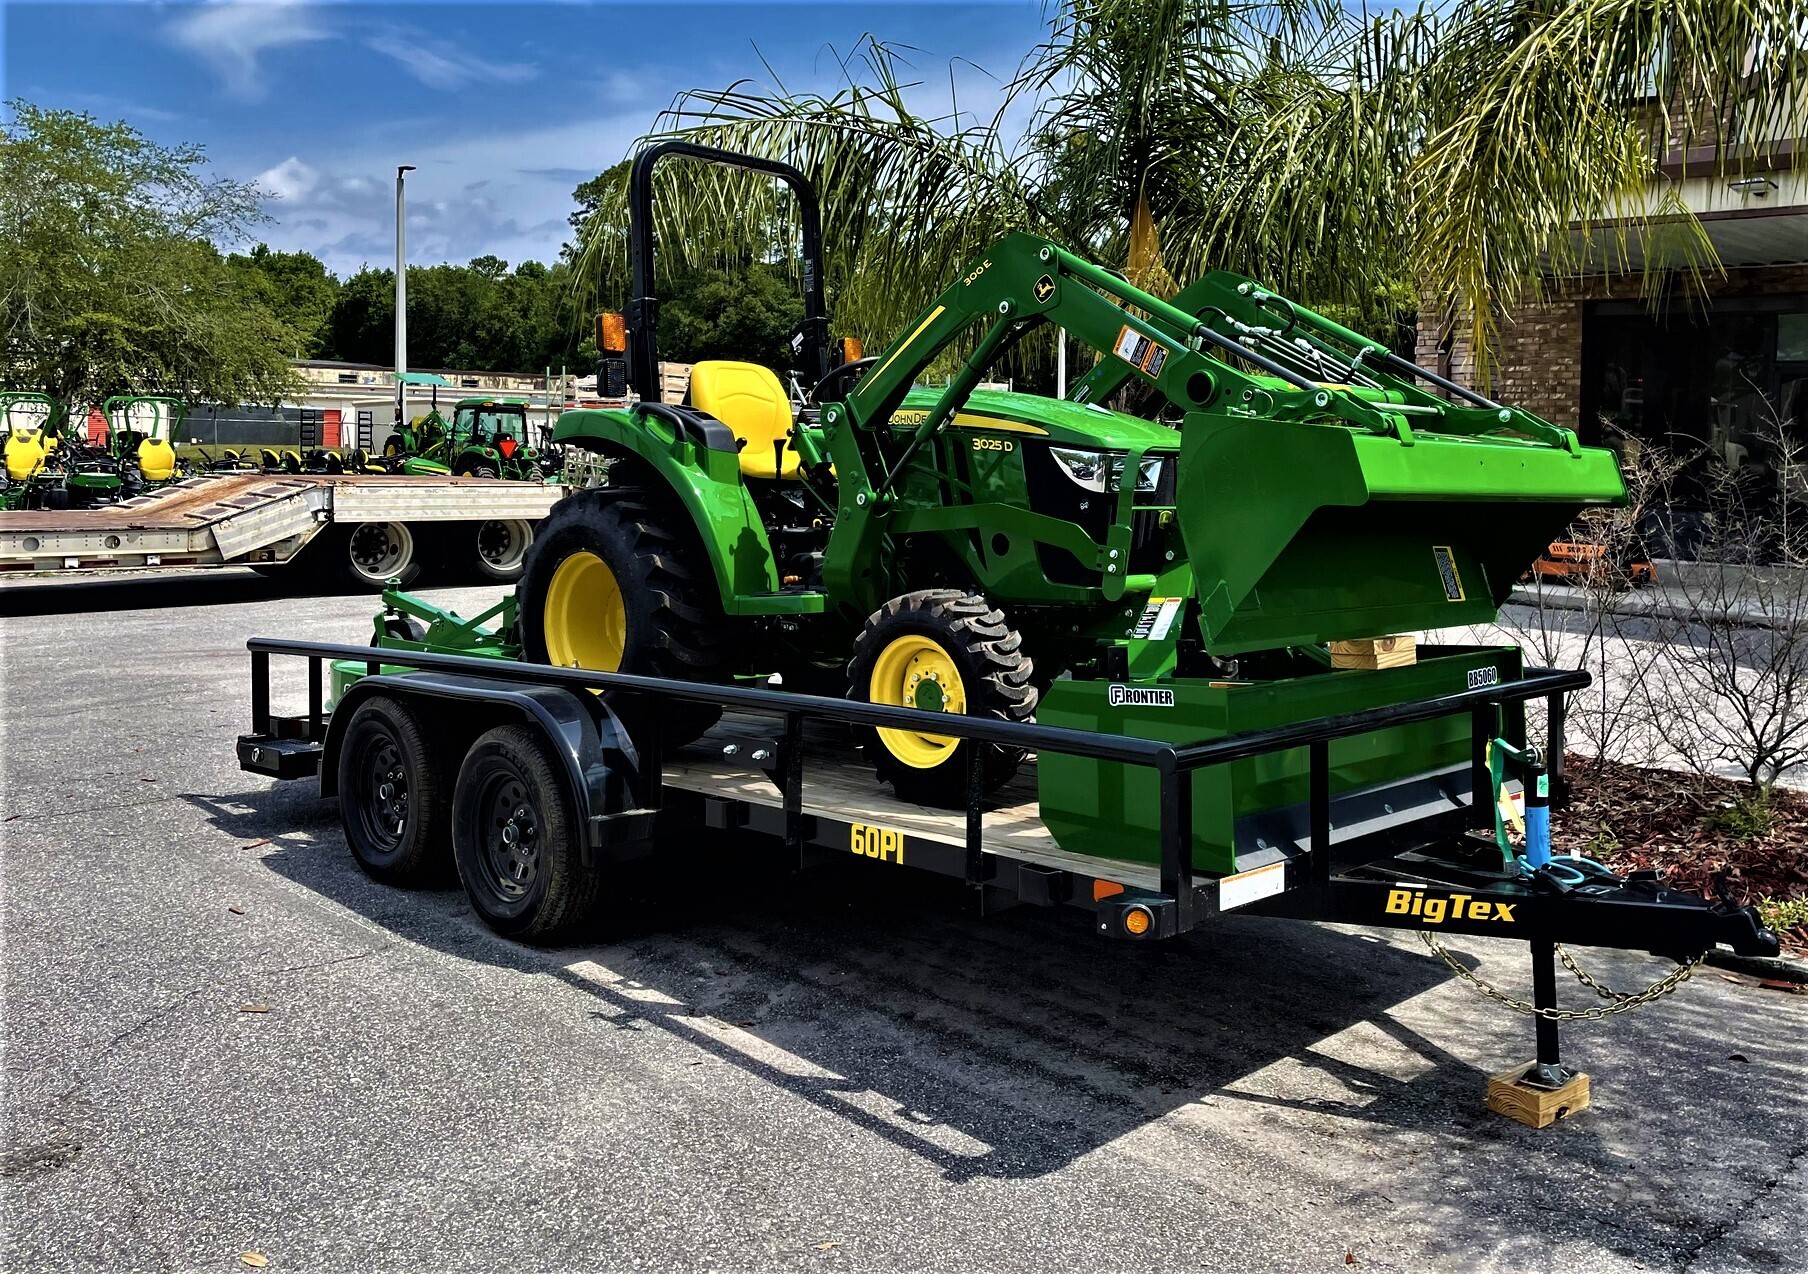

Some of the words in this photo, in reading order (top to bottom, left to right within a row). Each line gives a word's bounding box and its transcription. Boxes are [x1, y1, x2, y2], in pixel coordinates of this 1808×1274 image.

[963, 266, 984, 287] 300
[982, 259, 993, 269] E
[888, 414, 913, 424] JOHN
[972, 438, 1003, 451] 3025
[1004, 441, 1013, 452] D
[1468, 666, 1497, 687] BB5060
[1110, 686, 1173, 705] FRONTIER
[851, 822, 904, 865] 60PI
[1384, 889, 1518, 924] BigTex
